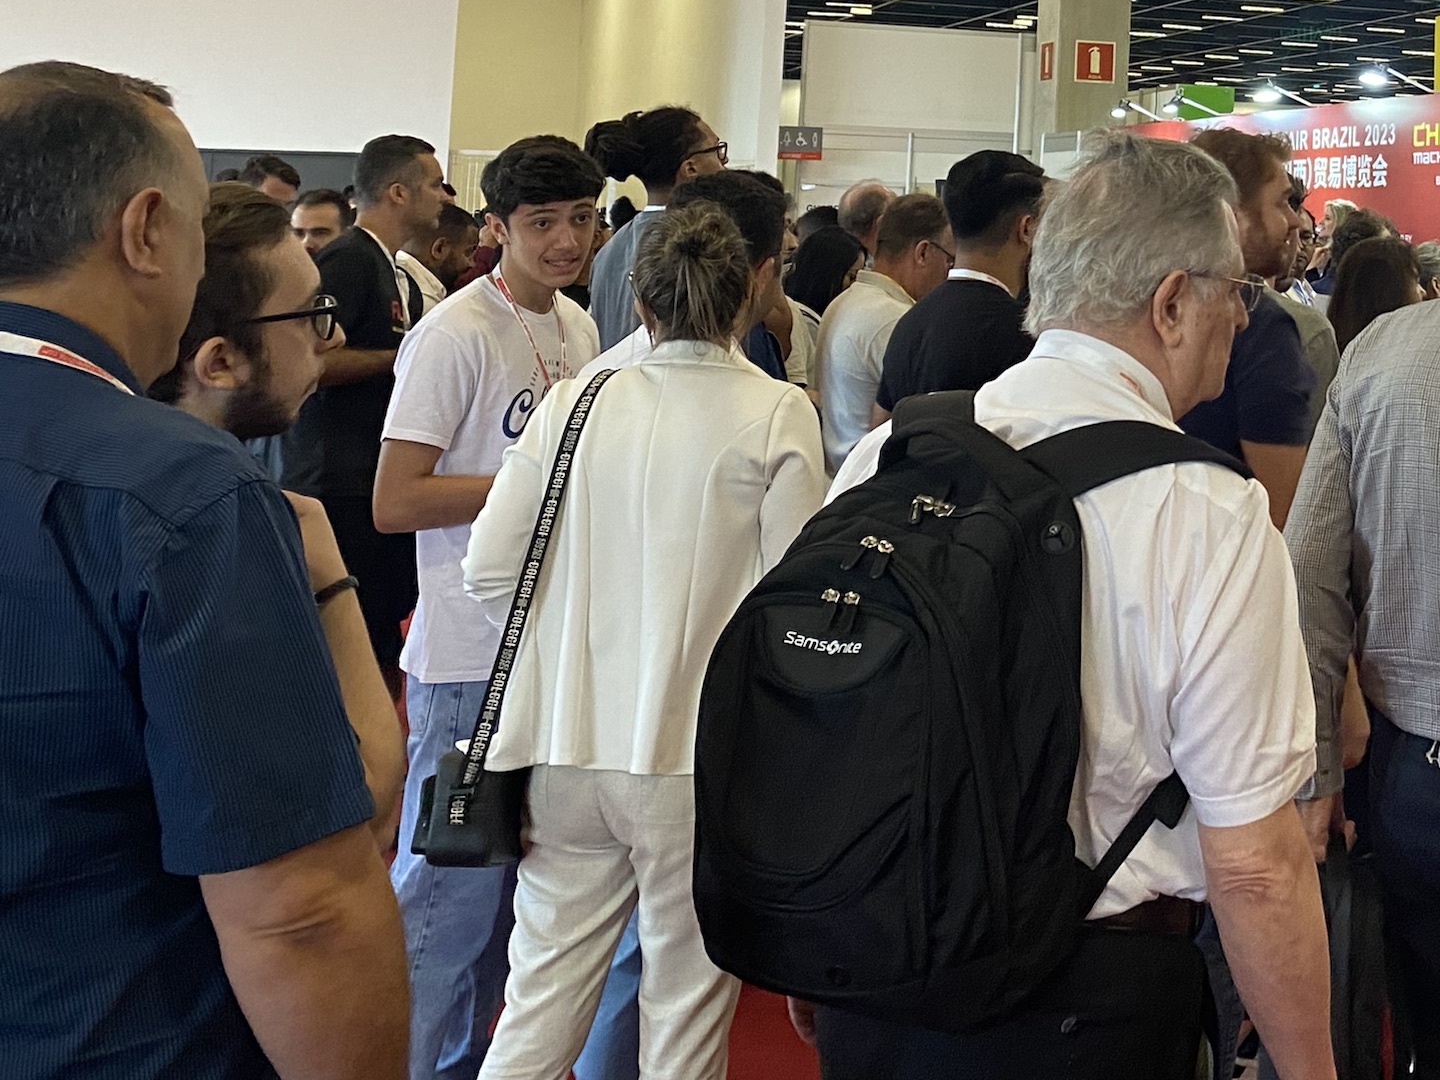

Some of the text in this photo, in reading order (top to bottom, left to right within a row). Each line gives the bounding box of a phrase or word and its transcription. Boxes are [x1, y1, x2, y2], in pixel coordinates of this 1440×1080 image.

[1285, 122, 1396, 151] AIR BRAZIL 2023
[783, 630, 863, 655] Samsonite
